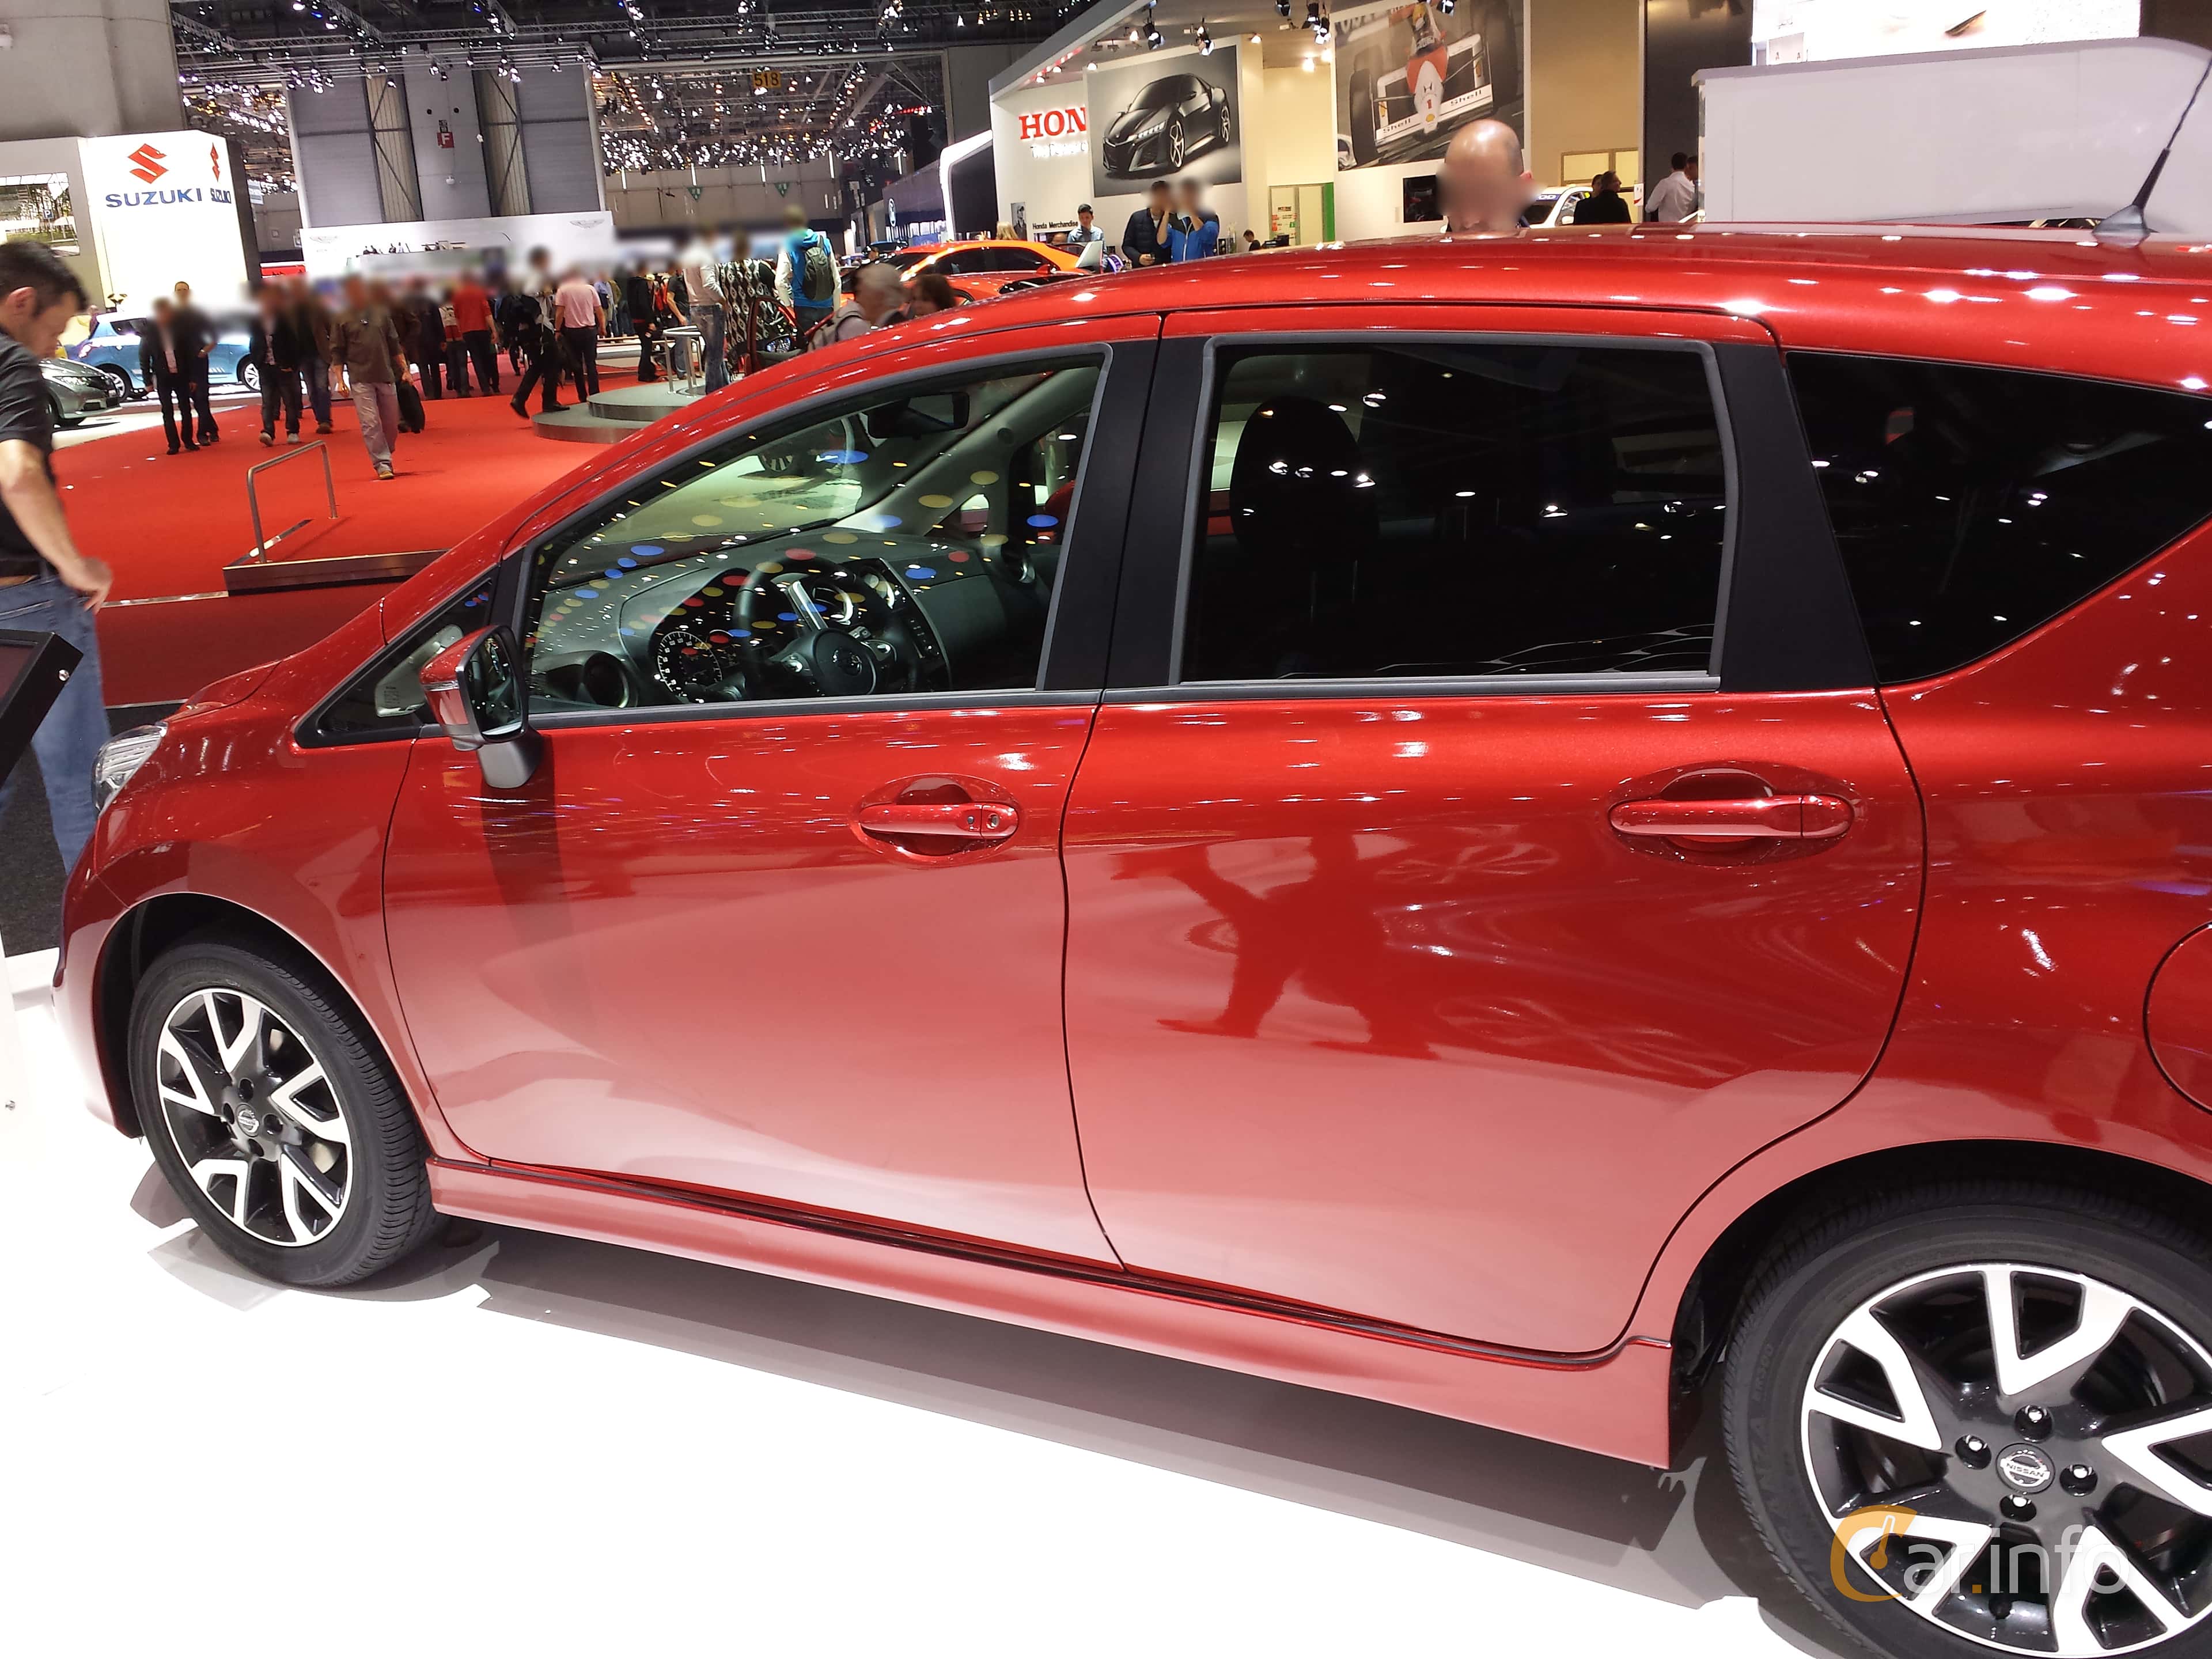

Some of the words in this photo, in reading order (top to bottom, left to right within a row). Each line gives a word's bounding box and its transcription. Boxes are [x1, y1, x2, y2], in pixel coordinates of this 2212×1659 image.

[755, 72, 779, 86] 518
[1427, 99, 1432, 109] 1
[1450, 89, 1482, 106] Shell
[1383, 118, 1411, 133] Shell
[441, 132, 450, 145] F
[105, 188, 203, 208] SUZUKI
[1048, 220, 1078, 229] Merchandise
[2006, 1463, 2044, 1478] NISSAN
